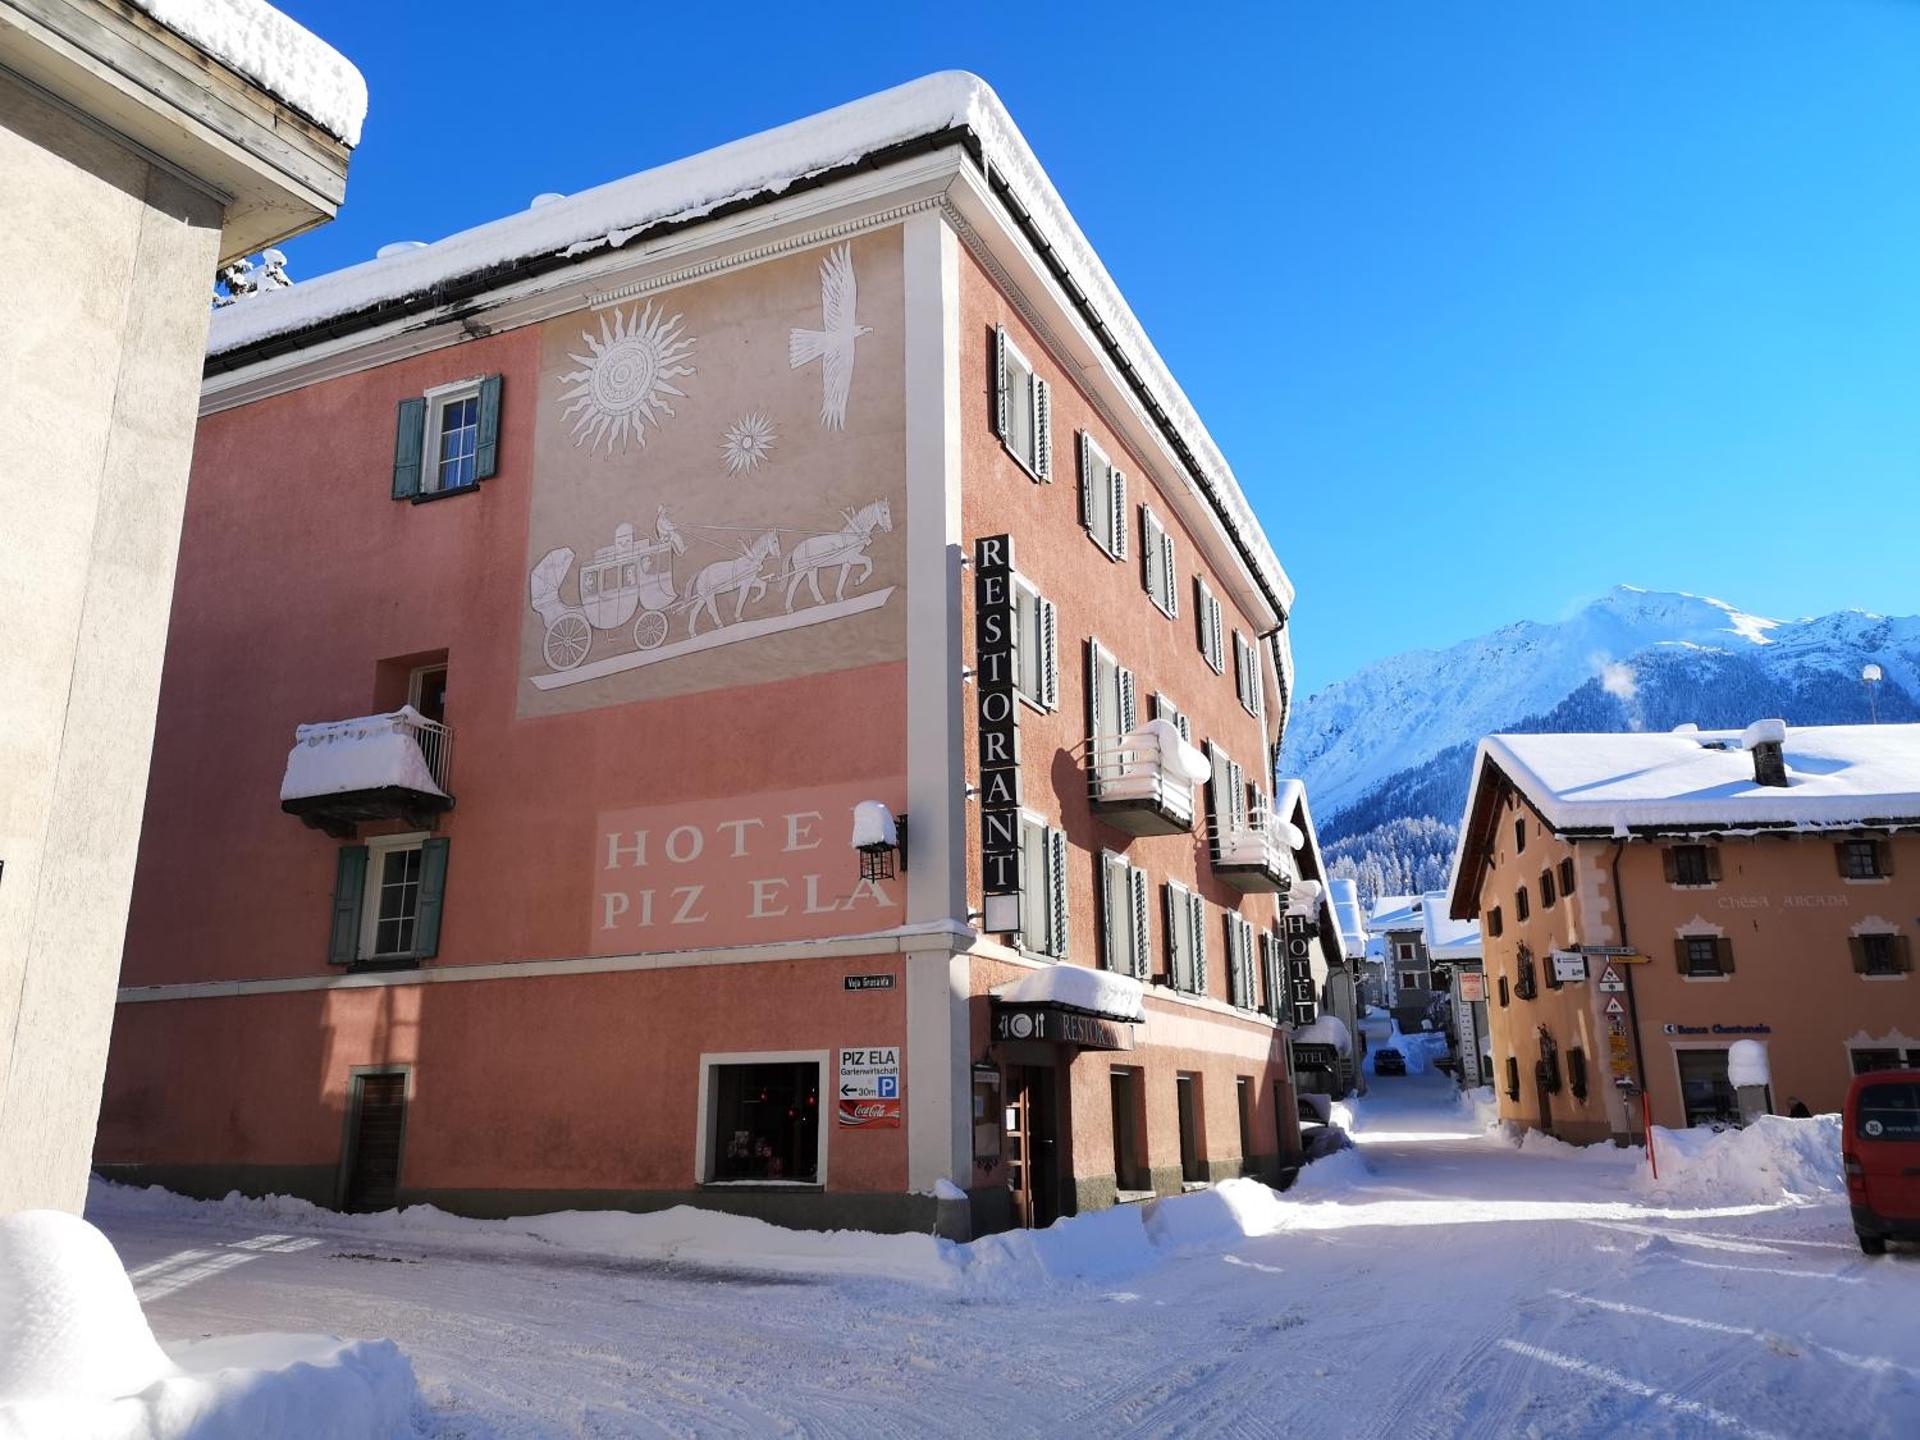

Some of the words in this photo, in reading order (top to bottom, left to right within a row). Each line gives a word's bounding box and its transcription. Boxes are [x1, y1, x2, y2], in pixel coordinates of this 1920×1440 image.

[981, 540, 1014, 886] RESTORANT
[604, 809, 858, 870] HOTE
[600, 885, 709, 930] PIZ
[746, 874, 897, 919] ELA
[1288, 917, 1313, 1023] HOTEL
[841, 1066, 898, 1076] Gartenwirtschaft
[843, 1051, 865, 1065] PIZ
[870, 1051, 896, 1064] ELA
[1294, 1051, 1327, 1063] OTEL
[858, 1087, 876, 1097] 30m
